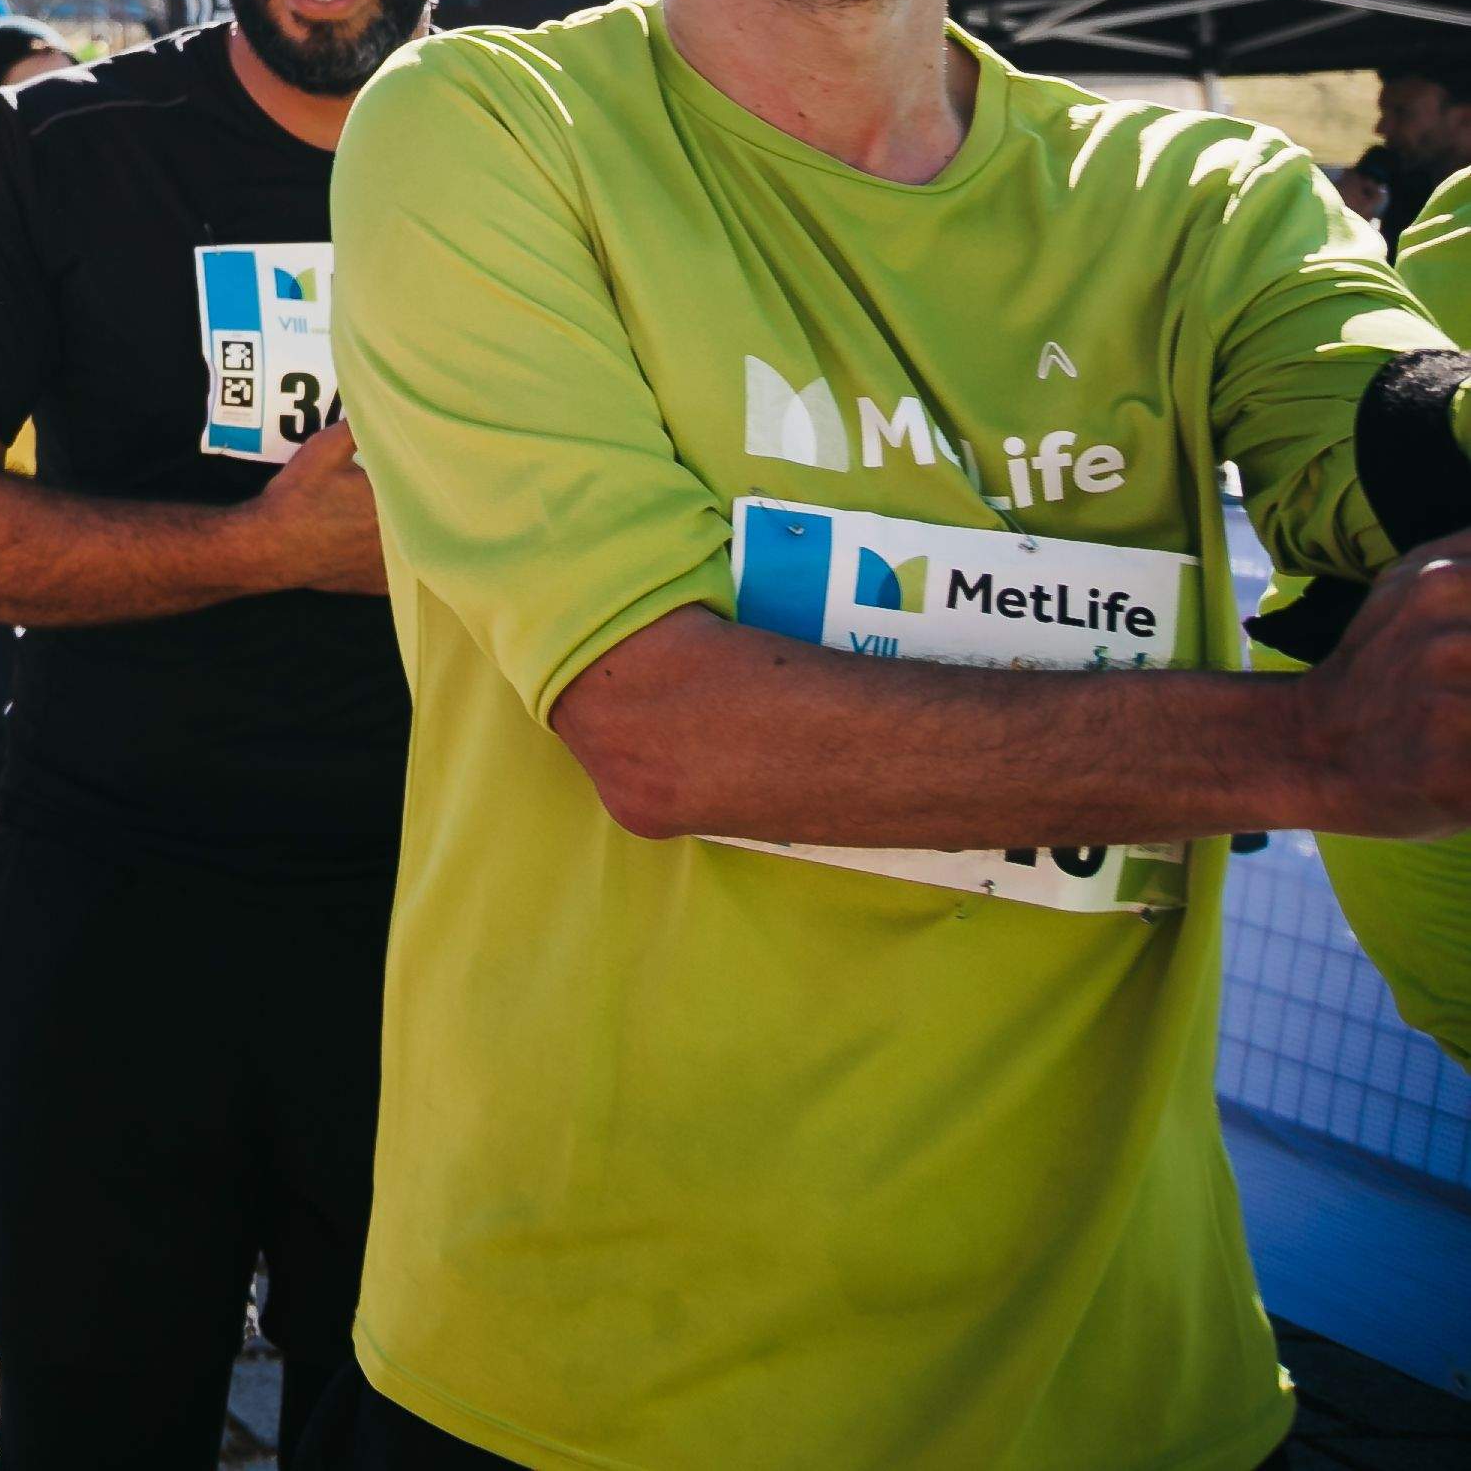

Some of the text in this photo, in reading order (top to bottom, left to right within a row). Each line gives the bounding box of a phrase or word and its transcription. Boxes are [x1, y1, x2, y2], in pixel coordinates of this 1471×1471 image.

[857, 395, 1126, 510] MLife
[946, 568, 1156, 638] MetLife
[849, 631, 898, 658] VIII
